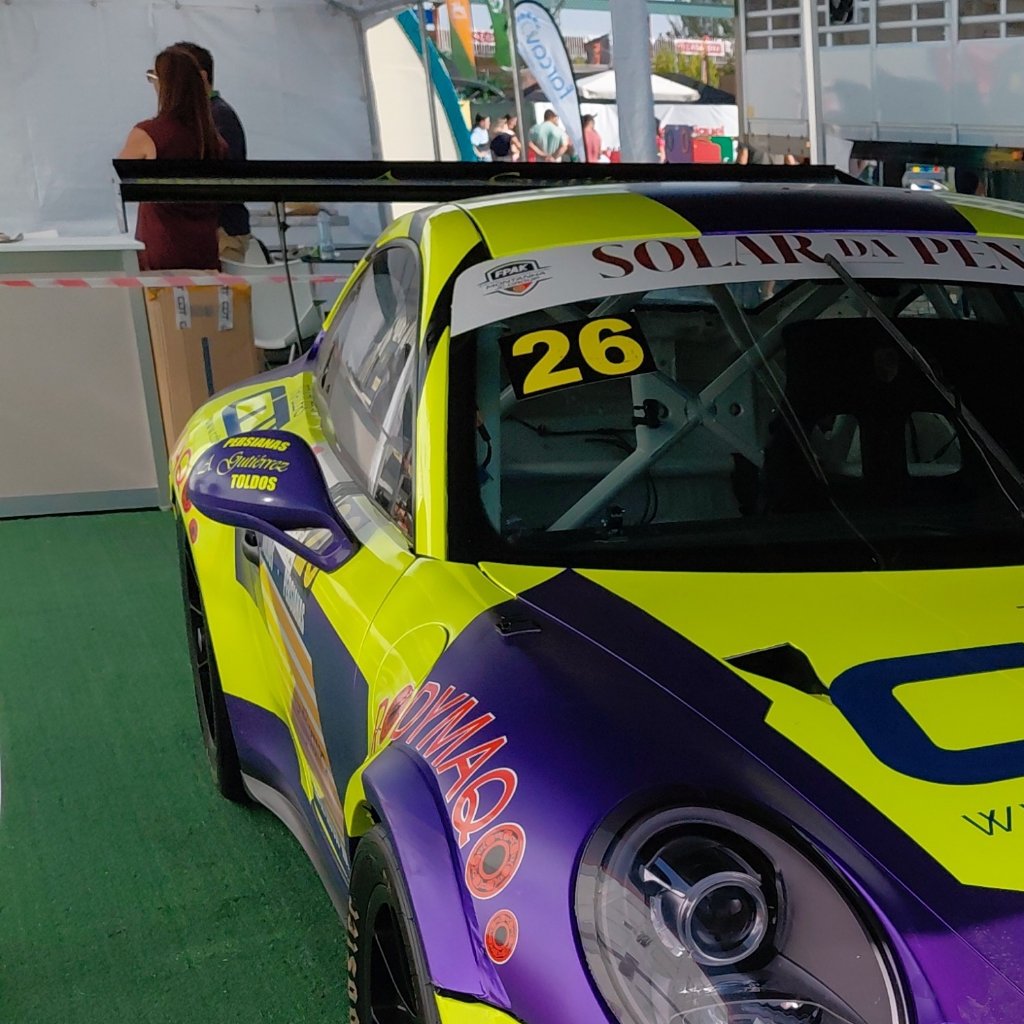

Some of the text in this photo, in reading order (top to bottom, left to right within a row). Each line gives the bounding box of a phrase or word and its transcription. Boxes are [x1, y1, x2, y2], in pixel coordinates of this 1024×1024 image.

[592, 235, 826, 278] SOLAR
[834, 237, 899, 258] DA
[494, 261, 530, 280] FPAK
[512, 318, 645, 395] 26
[222, 435, 292, 453] PERSIANAS
[230, 473, 278, 492] TOLDOS
